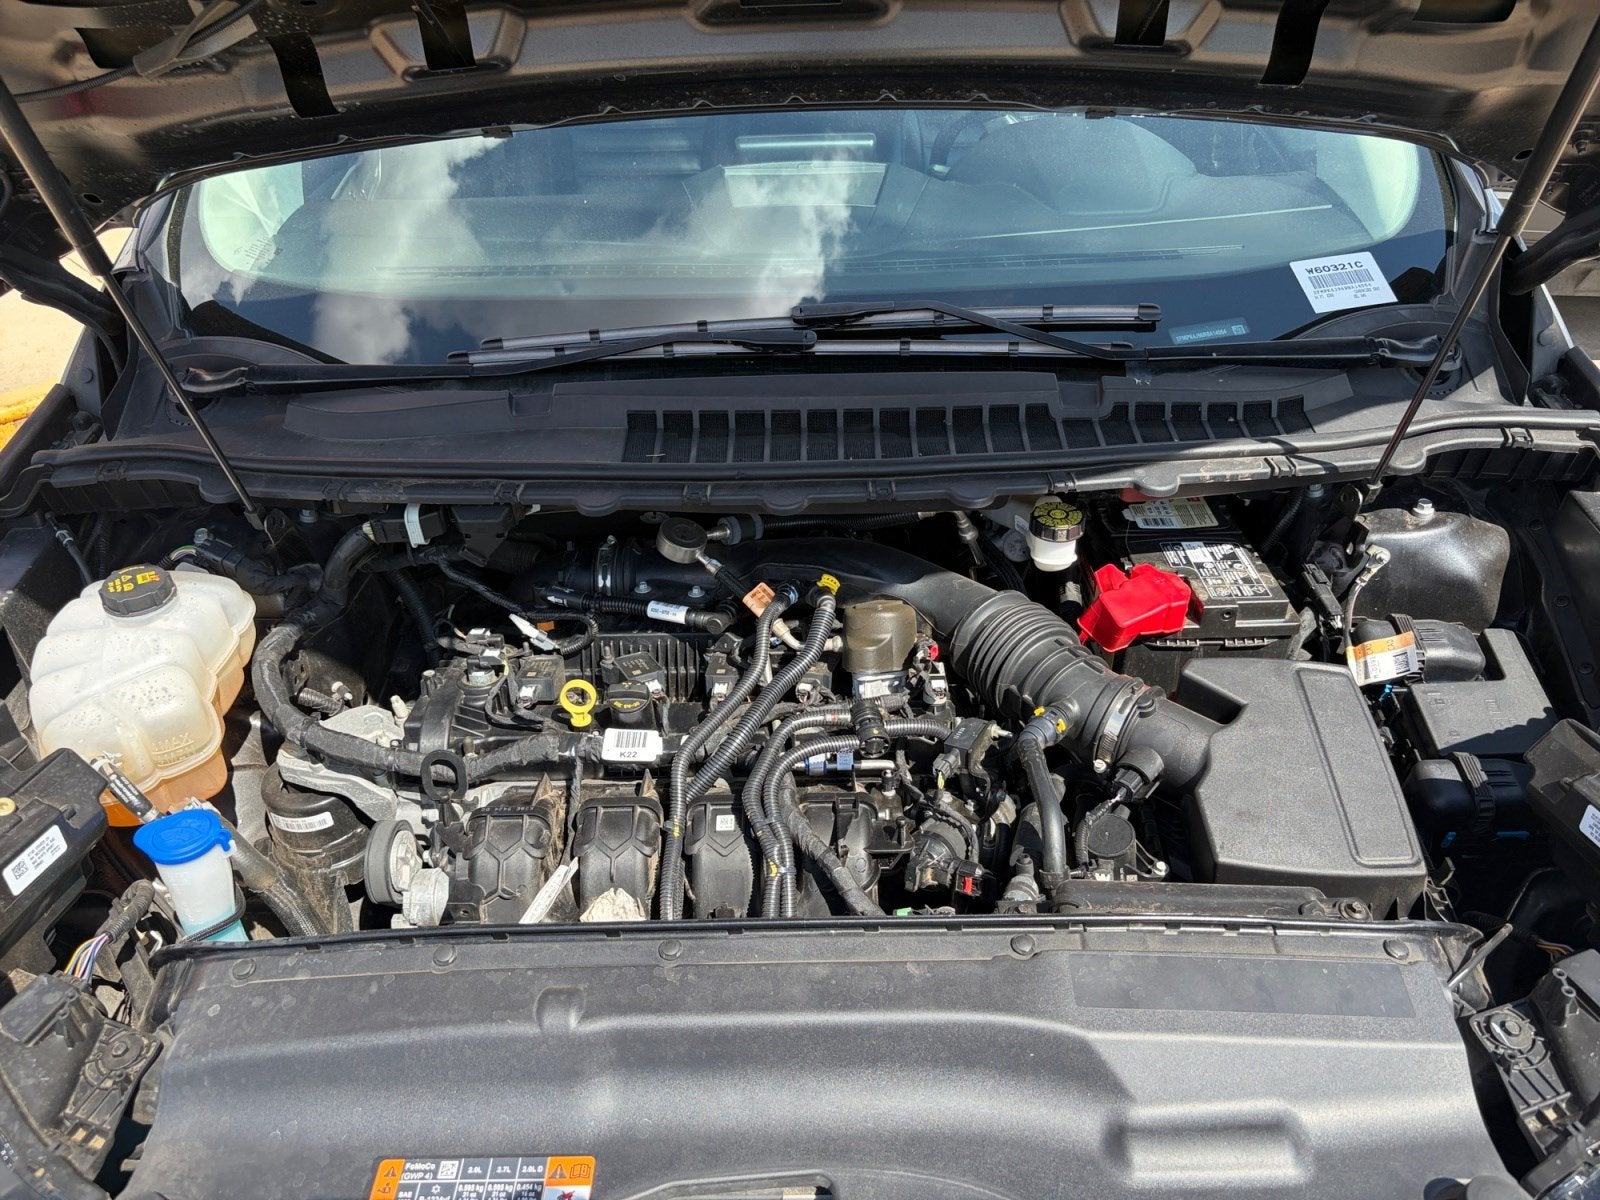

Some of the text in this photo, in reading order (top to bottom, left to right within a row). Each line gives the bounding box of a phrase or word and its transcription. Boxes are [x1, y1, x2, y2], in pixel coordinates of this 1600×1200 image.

[1305, 261, 1364, 275] W60321C
[405, 1162, 436, 1170] FoMoCo
[467, 1166, 482, 1174] 2.0L
[401, 1172, 423, 1180] (GWP
